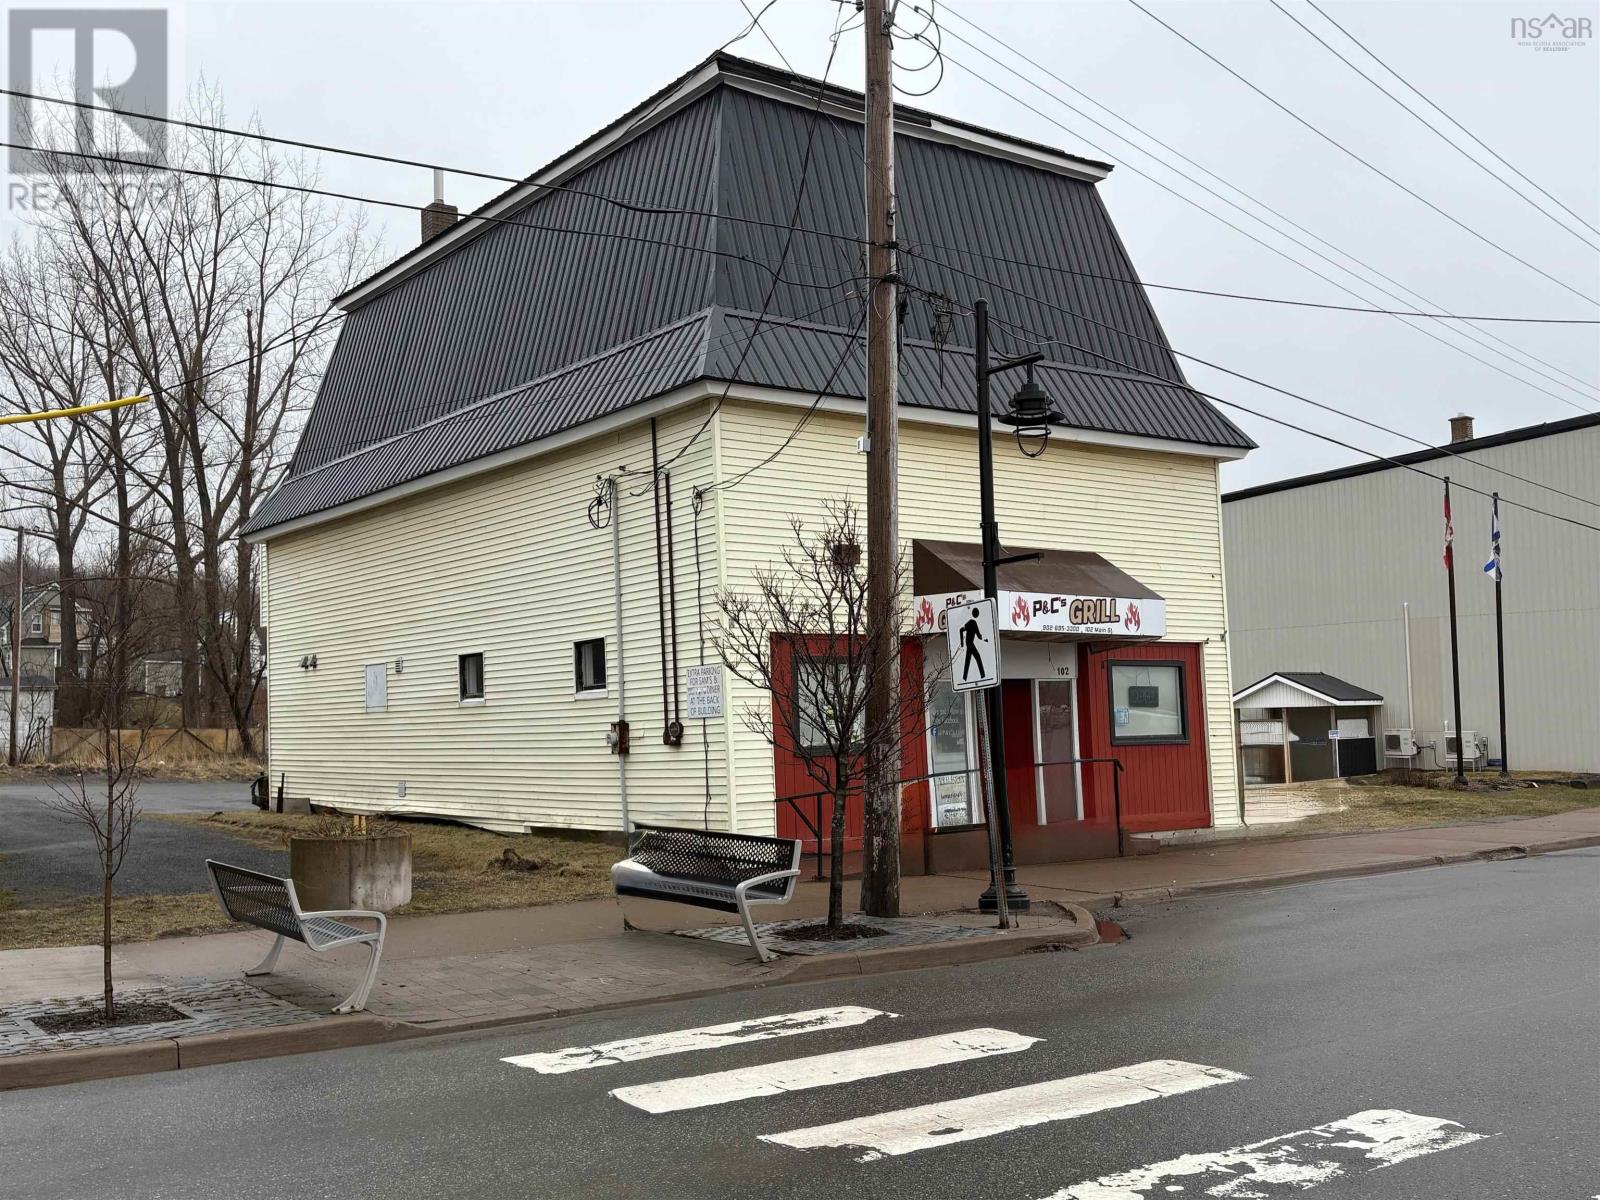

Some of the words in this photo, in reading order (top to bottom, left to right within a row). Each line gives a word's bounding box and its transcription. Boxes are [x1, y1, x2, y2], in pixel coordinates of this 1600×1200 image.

[1033, 597, 1067, 617] P&C's
[1069, 598, 1120, 625] GRILL
[701, 666, 721, 675] PARKING
[1057, 666, 1070, 676] 102
[690, 677, 698, 686] FOR
[696, 696, 706, 705] THE
[707, 695, 720, 704] BACK
[690, 707, 697, 716] OF
[698, 705, 721, 716] BUILDING
